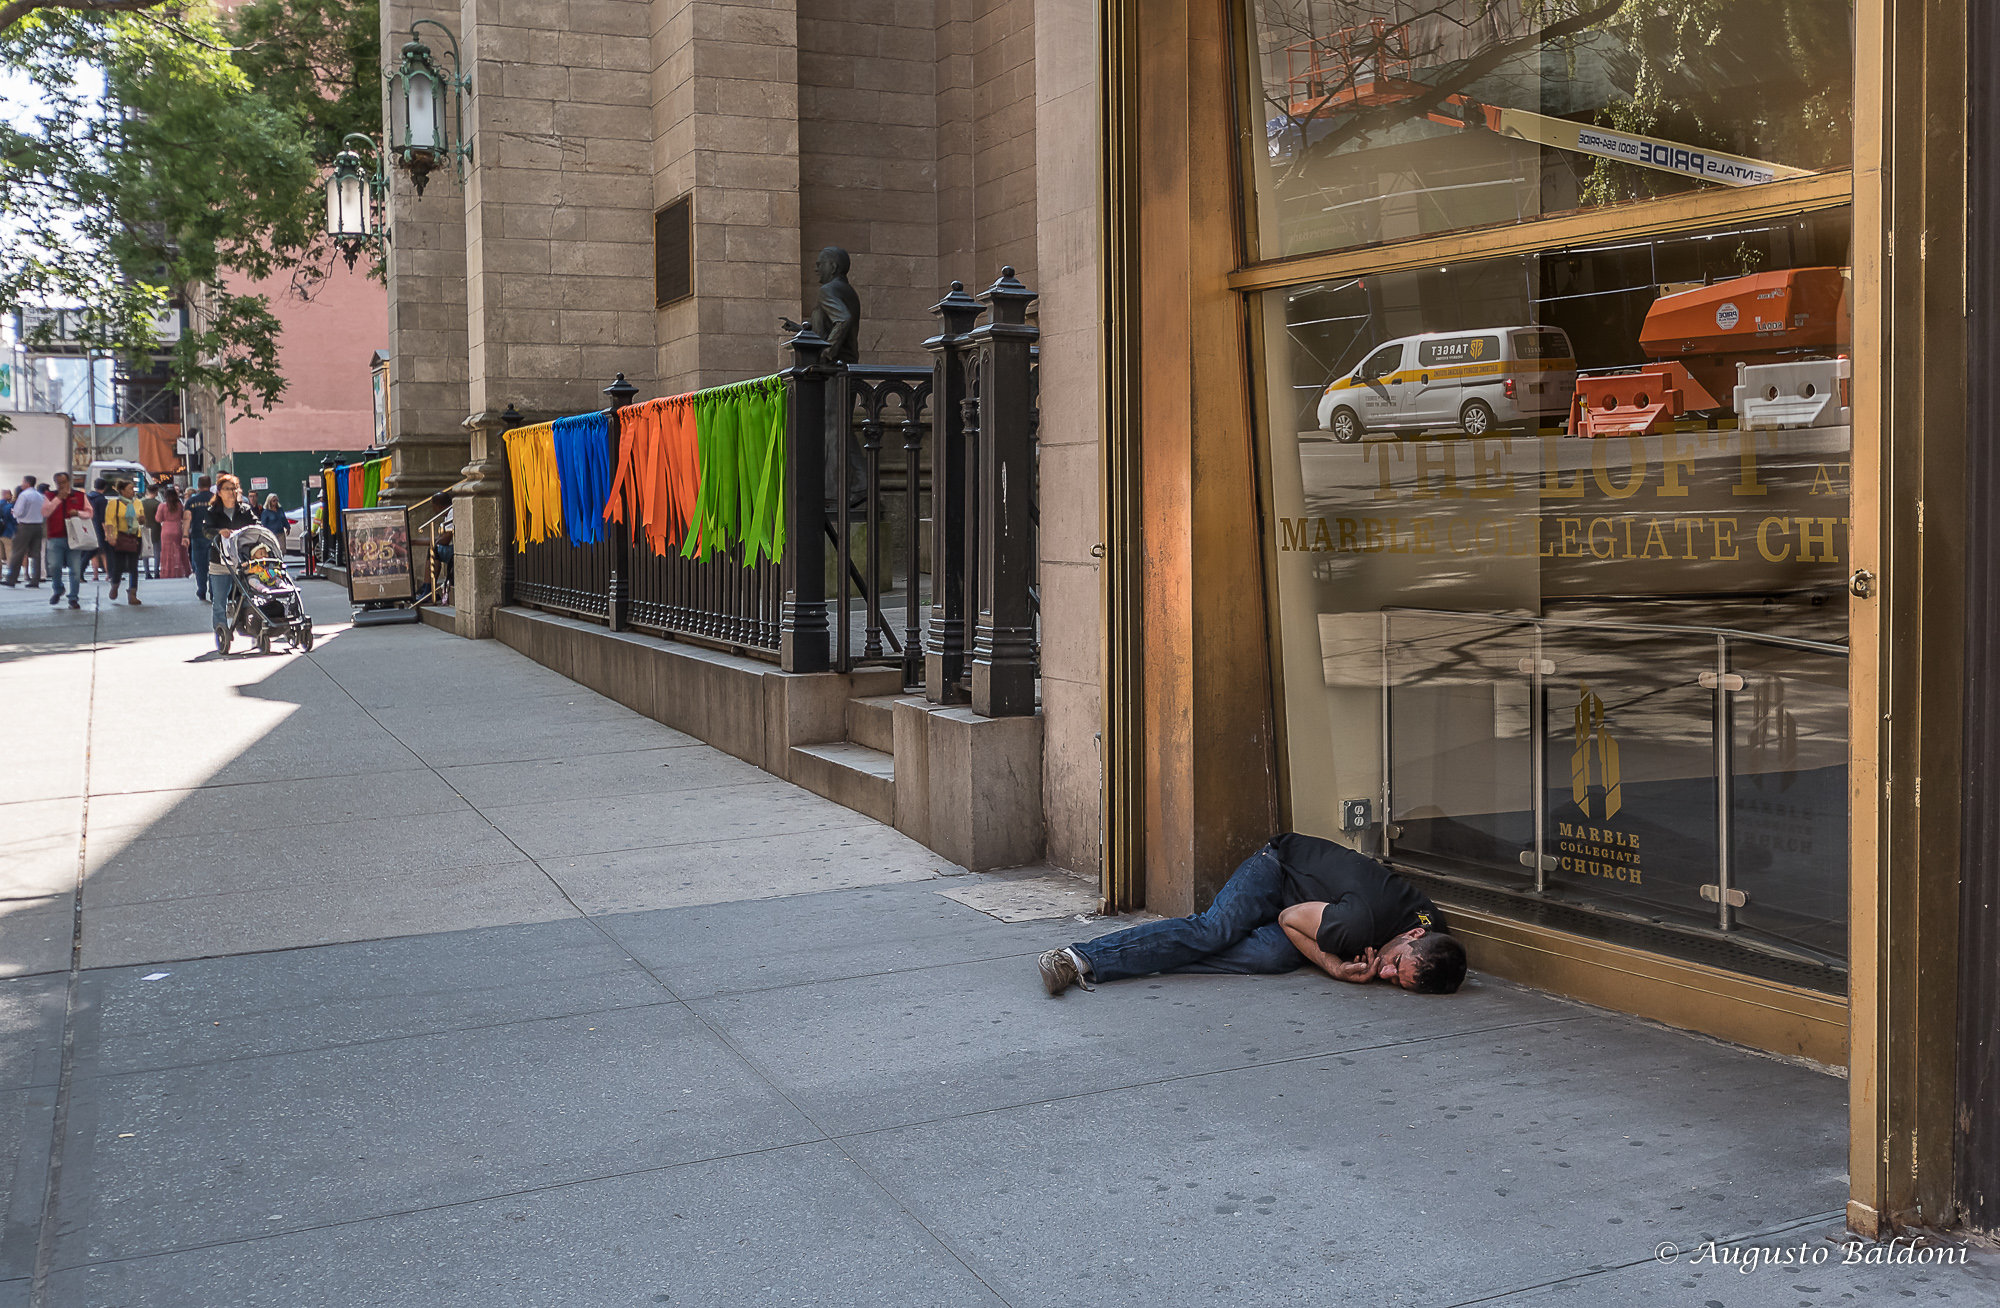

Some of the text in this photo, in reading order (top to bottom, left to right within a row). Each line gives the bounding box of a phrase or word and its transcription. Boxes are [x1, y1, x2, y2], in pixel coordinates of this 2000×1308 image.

[1363, 431, 1515, 499] THE
[1537, 417, 1778, 498] LOFT
[362, 540, 394, 561] 25
[1280, 517, 1436, 554] MARBLE
[1447, 516, 1740, 561] COLLEGIATE
[1559, 822, 1640, 849] MARBLE
[1560, 841, 1641, 864] COLLEGIATE
[1561, 856, 1642, 885] CHURCH
